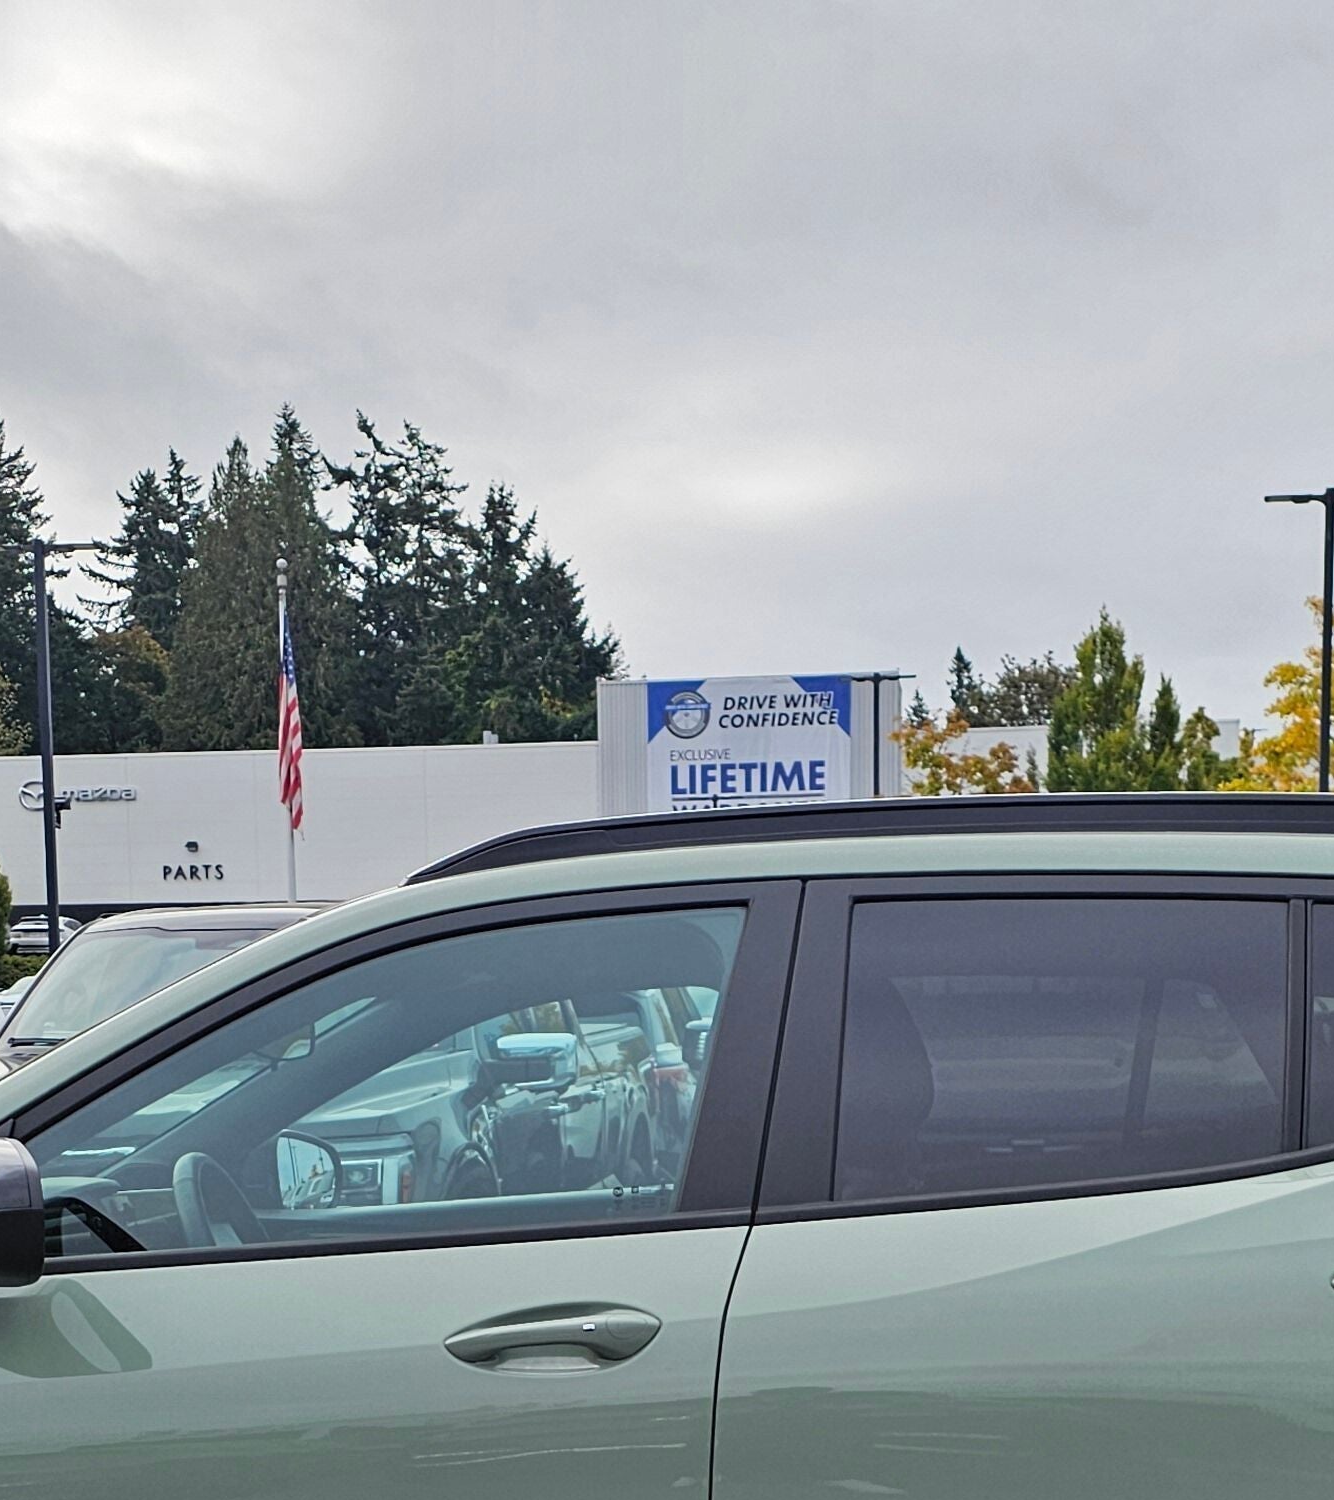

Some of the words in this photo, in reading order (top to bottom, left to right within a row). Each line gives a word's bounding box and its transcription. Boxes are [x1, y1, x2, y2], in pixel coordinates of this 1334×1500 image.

[723, 694, 777, 711] DRIVE
[784, 691, 834, 709] WITH
[718, 710, 839, 729] CONFIDENCE
[670, 749, 730, 762] EXCLUSIVE
[670, 760, 826, 795] LIFETIME
[163, 864, 225, 881] PARTS
